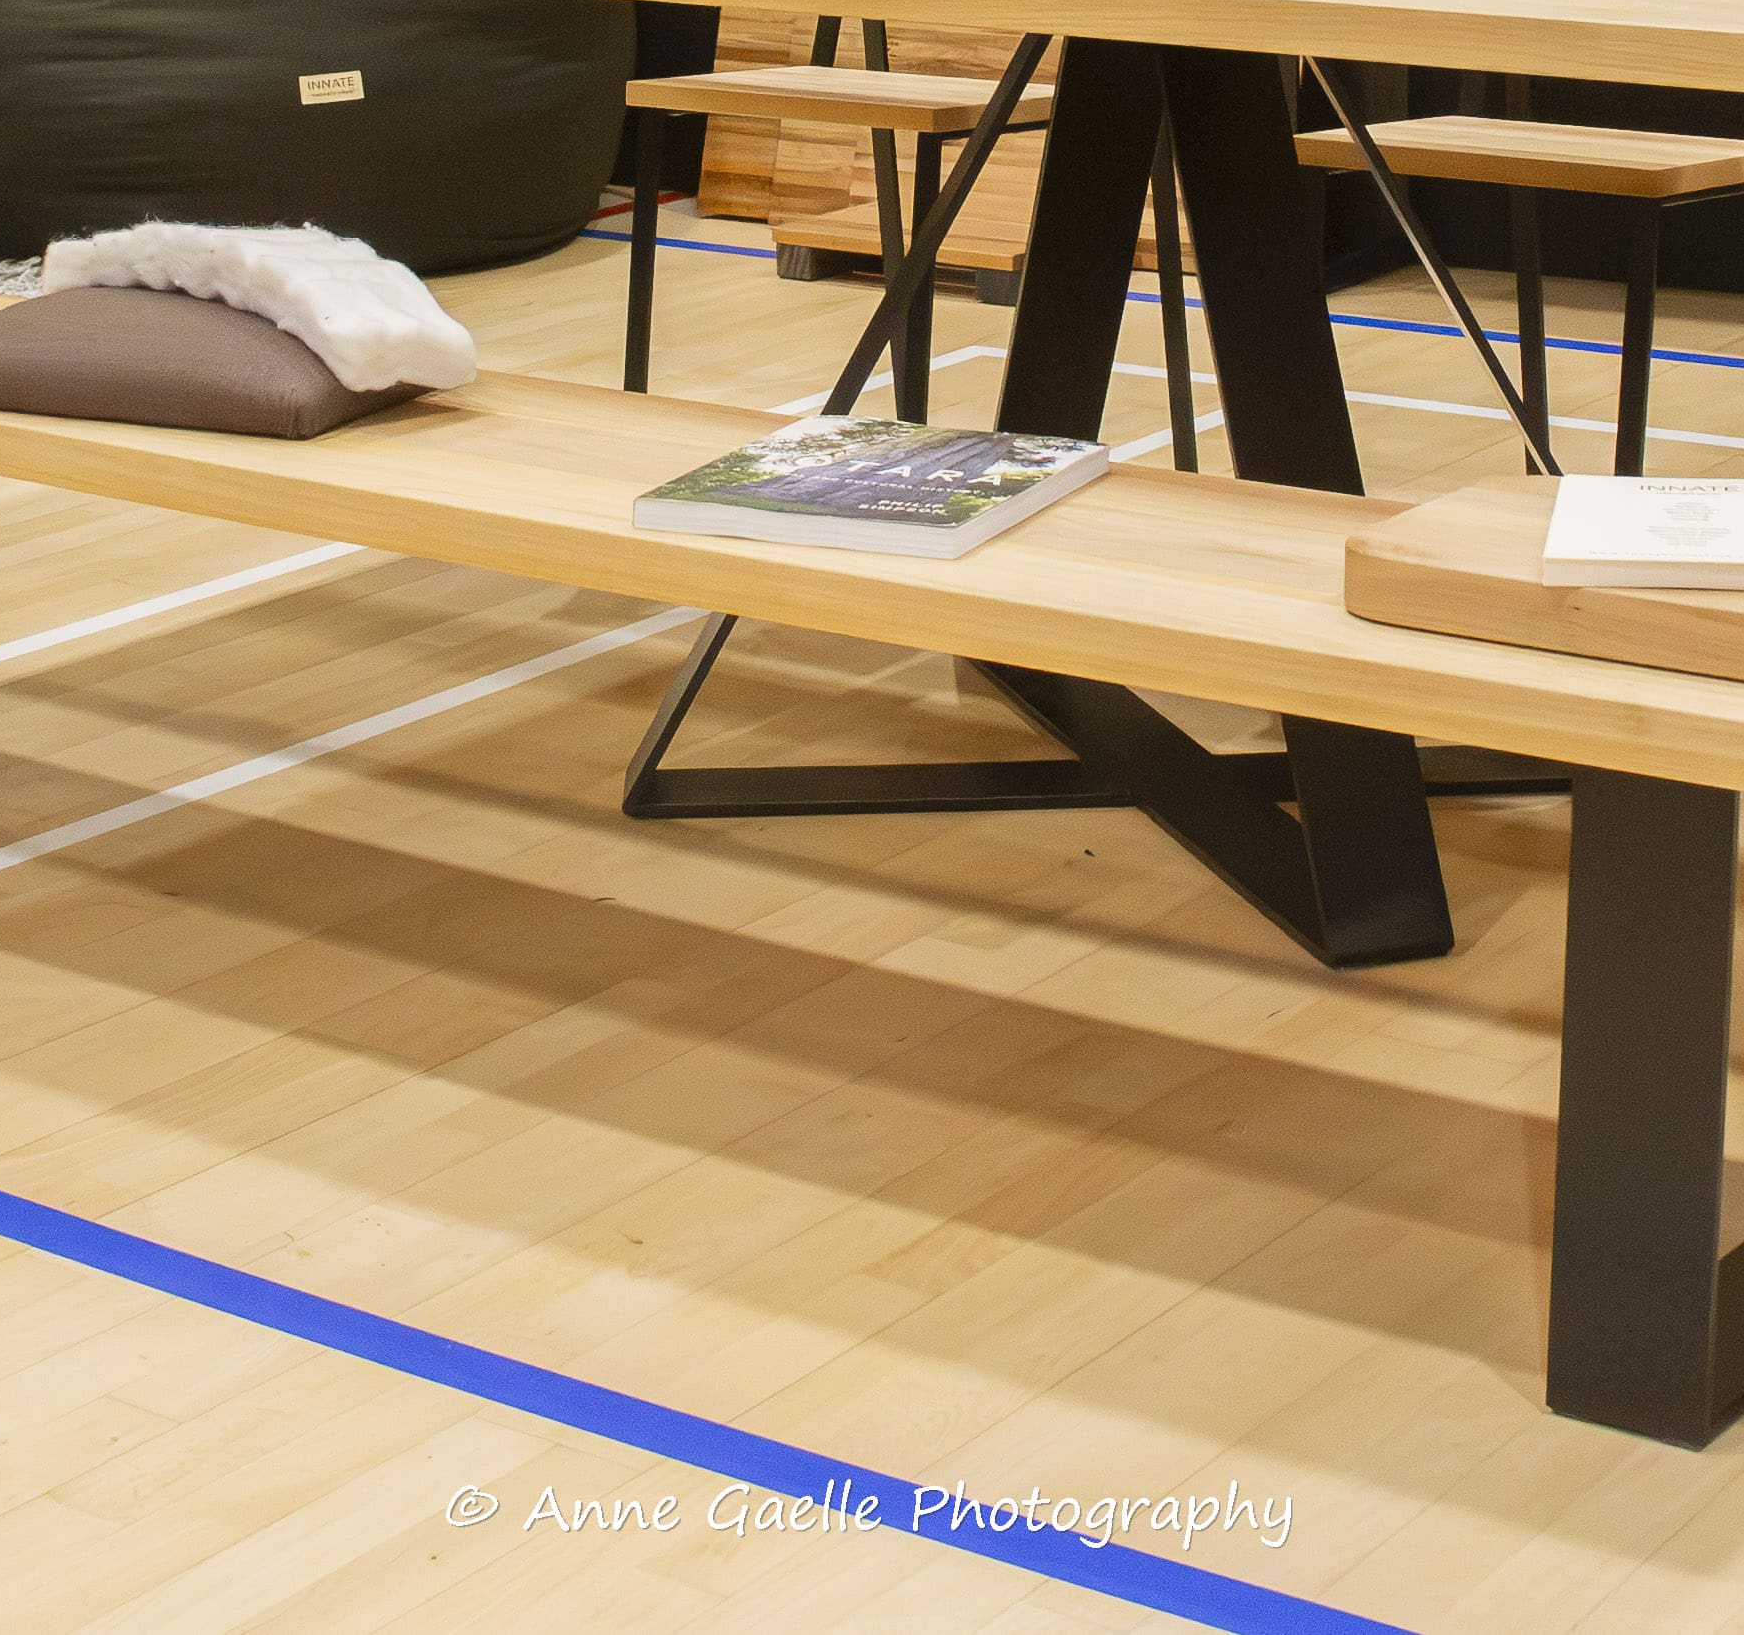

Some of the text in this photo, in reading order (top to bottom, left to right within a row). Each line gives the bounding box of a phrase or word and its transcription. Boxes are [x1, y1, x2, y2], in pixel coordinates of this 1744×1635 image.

[307, 76, 354, 91] INNATE
[769, 454, 1002, 486] OTARA
[1640, 484, 1742, 493] INNATE
